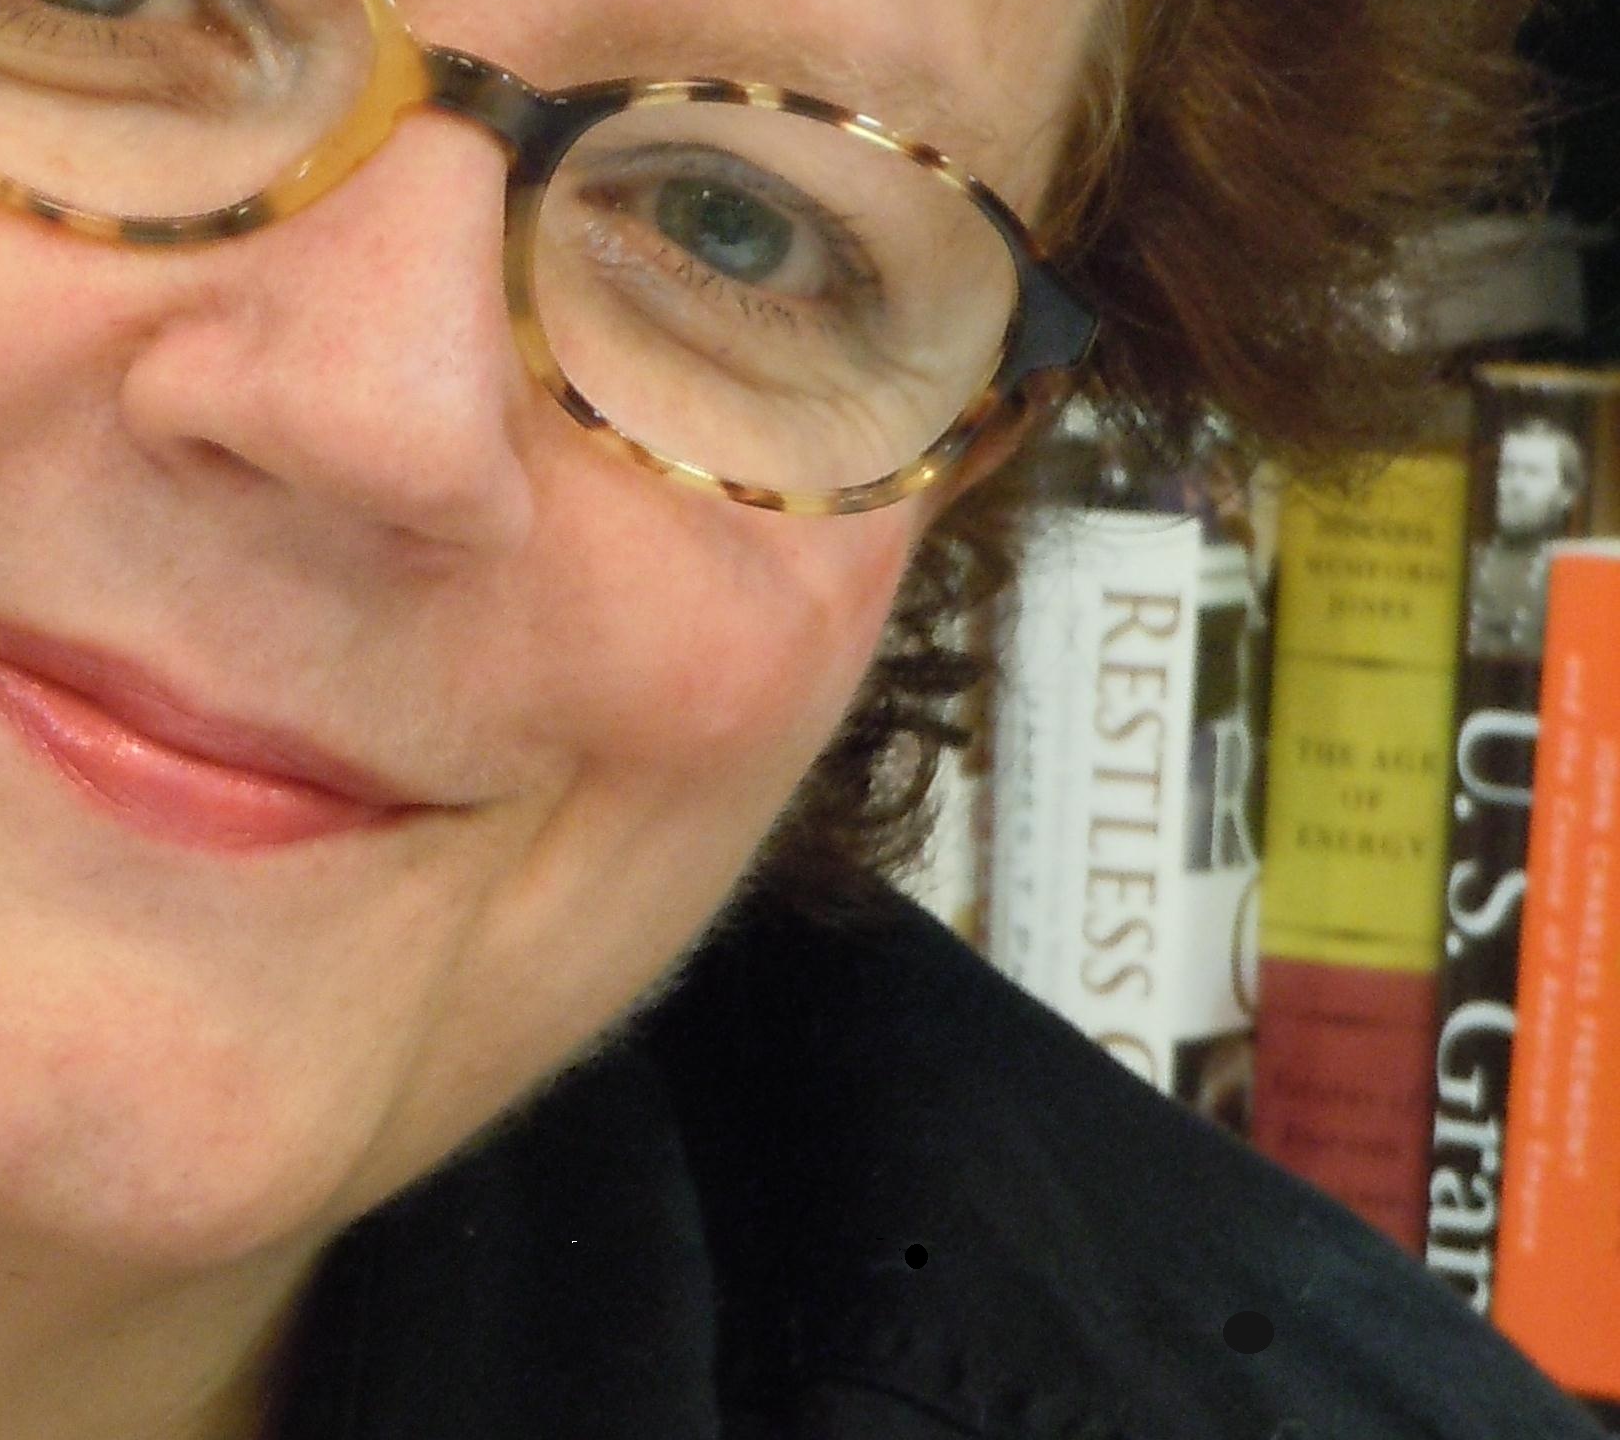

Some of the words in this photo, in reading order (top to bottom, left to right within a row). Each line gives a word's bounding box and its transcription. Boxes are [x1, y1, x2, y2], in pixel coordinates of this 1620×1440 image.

[1560, 654, 1586, 716] and
[1296, 736, 1361, 770] THE
[1373, 740, 1441, 777] AGE
[1454, 709, 1542, 820] U.
[1556, 726, 1581, 782] the
[1079, 588, 1183, 1000] RESTLESS
[1340, 789, 1382, 813] OF
[1294, 825, 1429, 865] ENERGY
[1445, 859, 1530, 956] S.
[1543, 920, 1564, 958] of
[1532, 971, 1564, 1127] American
[1425, 1000, 1519, 1314] Gran
[1519, 1139, 1551, 1255] Empire
